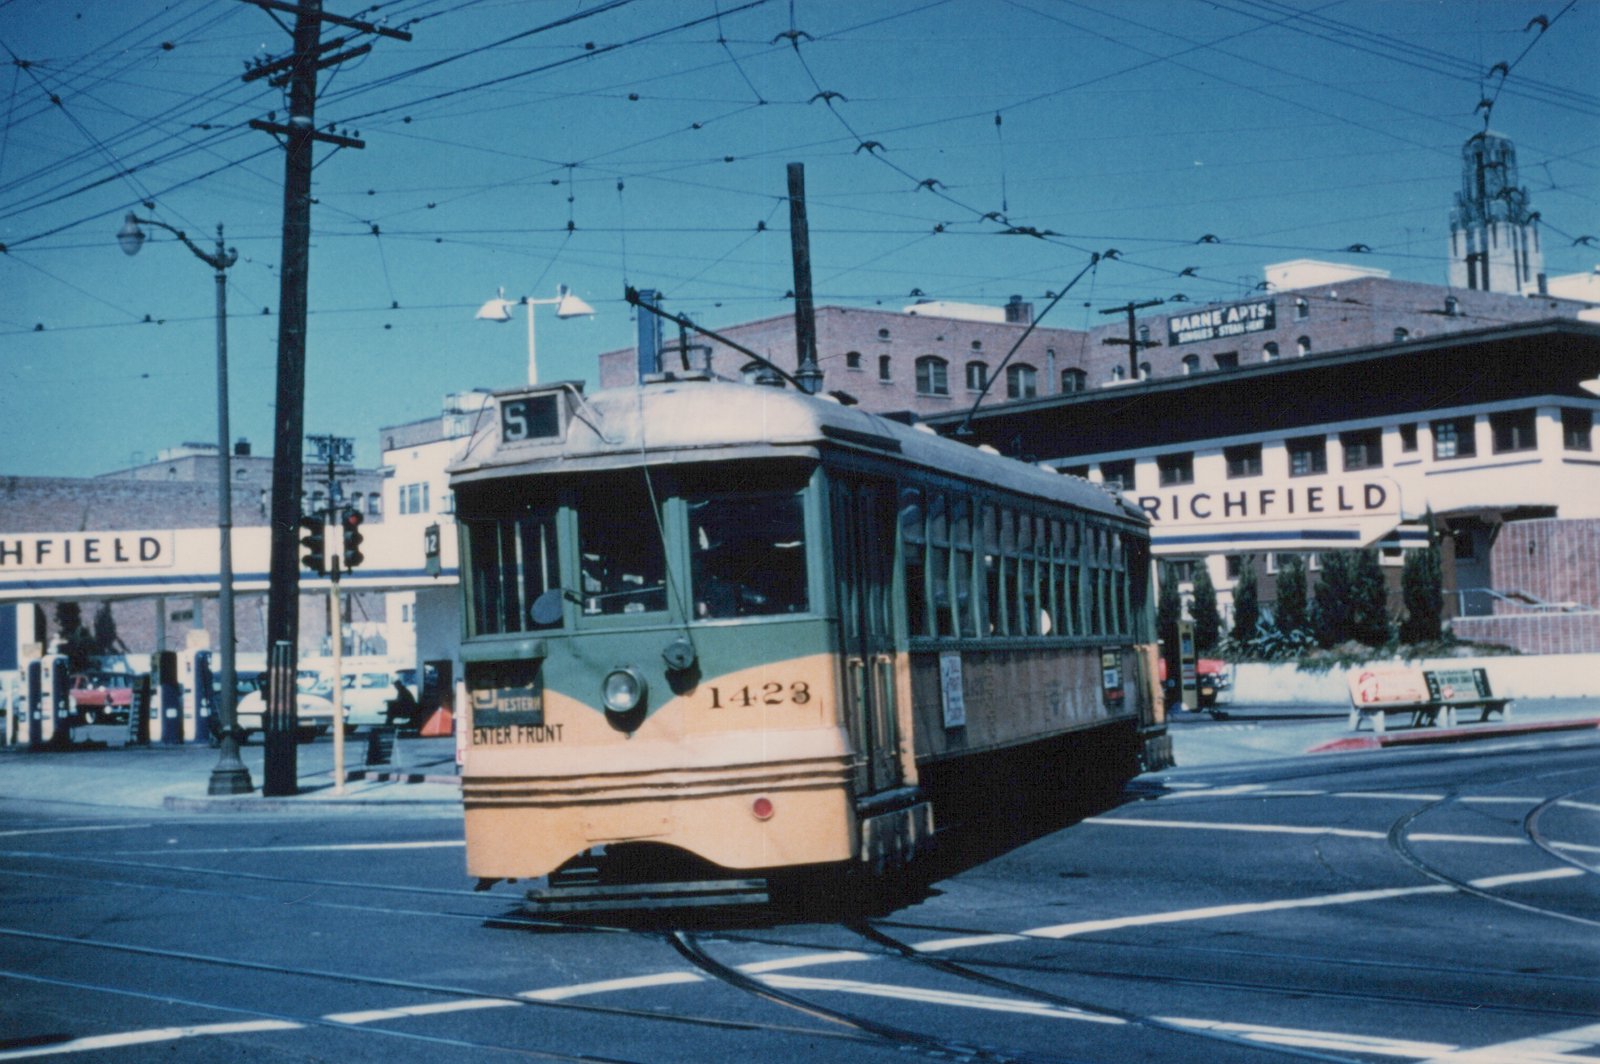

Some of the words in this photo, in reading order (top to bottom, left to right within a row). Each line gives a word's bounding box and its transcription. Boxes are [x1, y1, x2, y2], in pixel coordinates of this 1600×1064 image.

[505, 402, 528, 441] S
[1139, 483, 1387, 521] RICHFIELD
[0, 537, 161, 566] HFIELD
[708, 681, 811, 709] 1423
[473, 726, 512, 746] ENTER
[517, 723, 563, 744] FRONT
